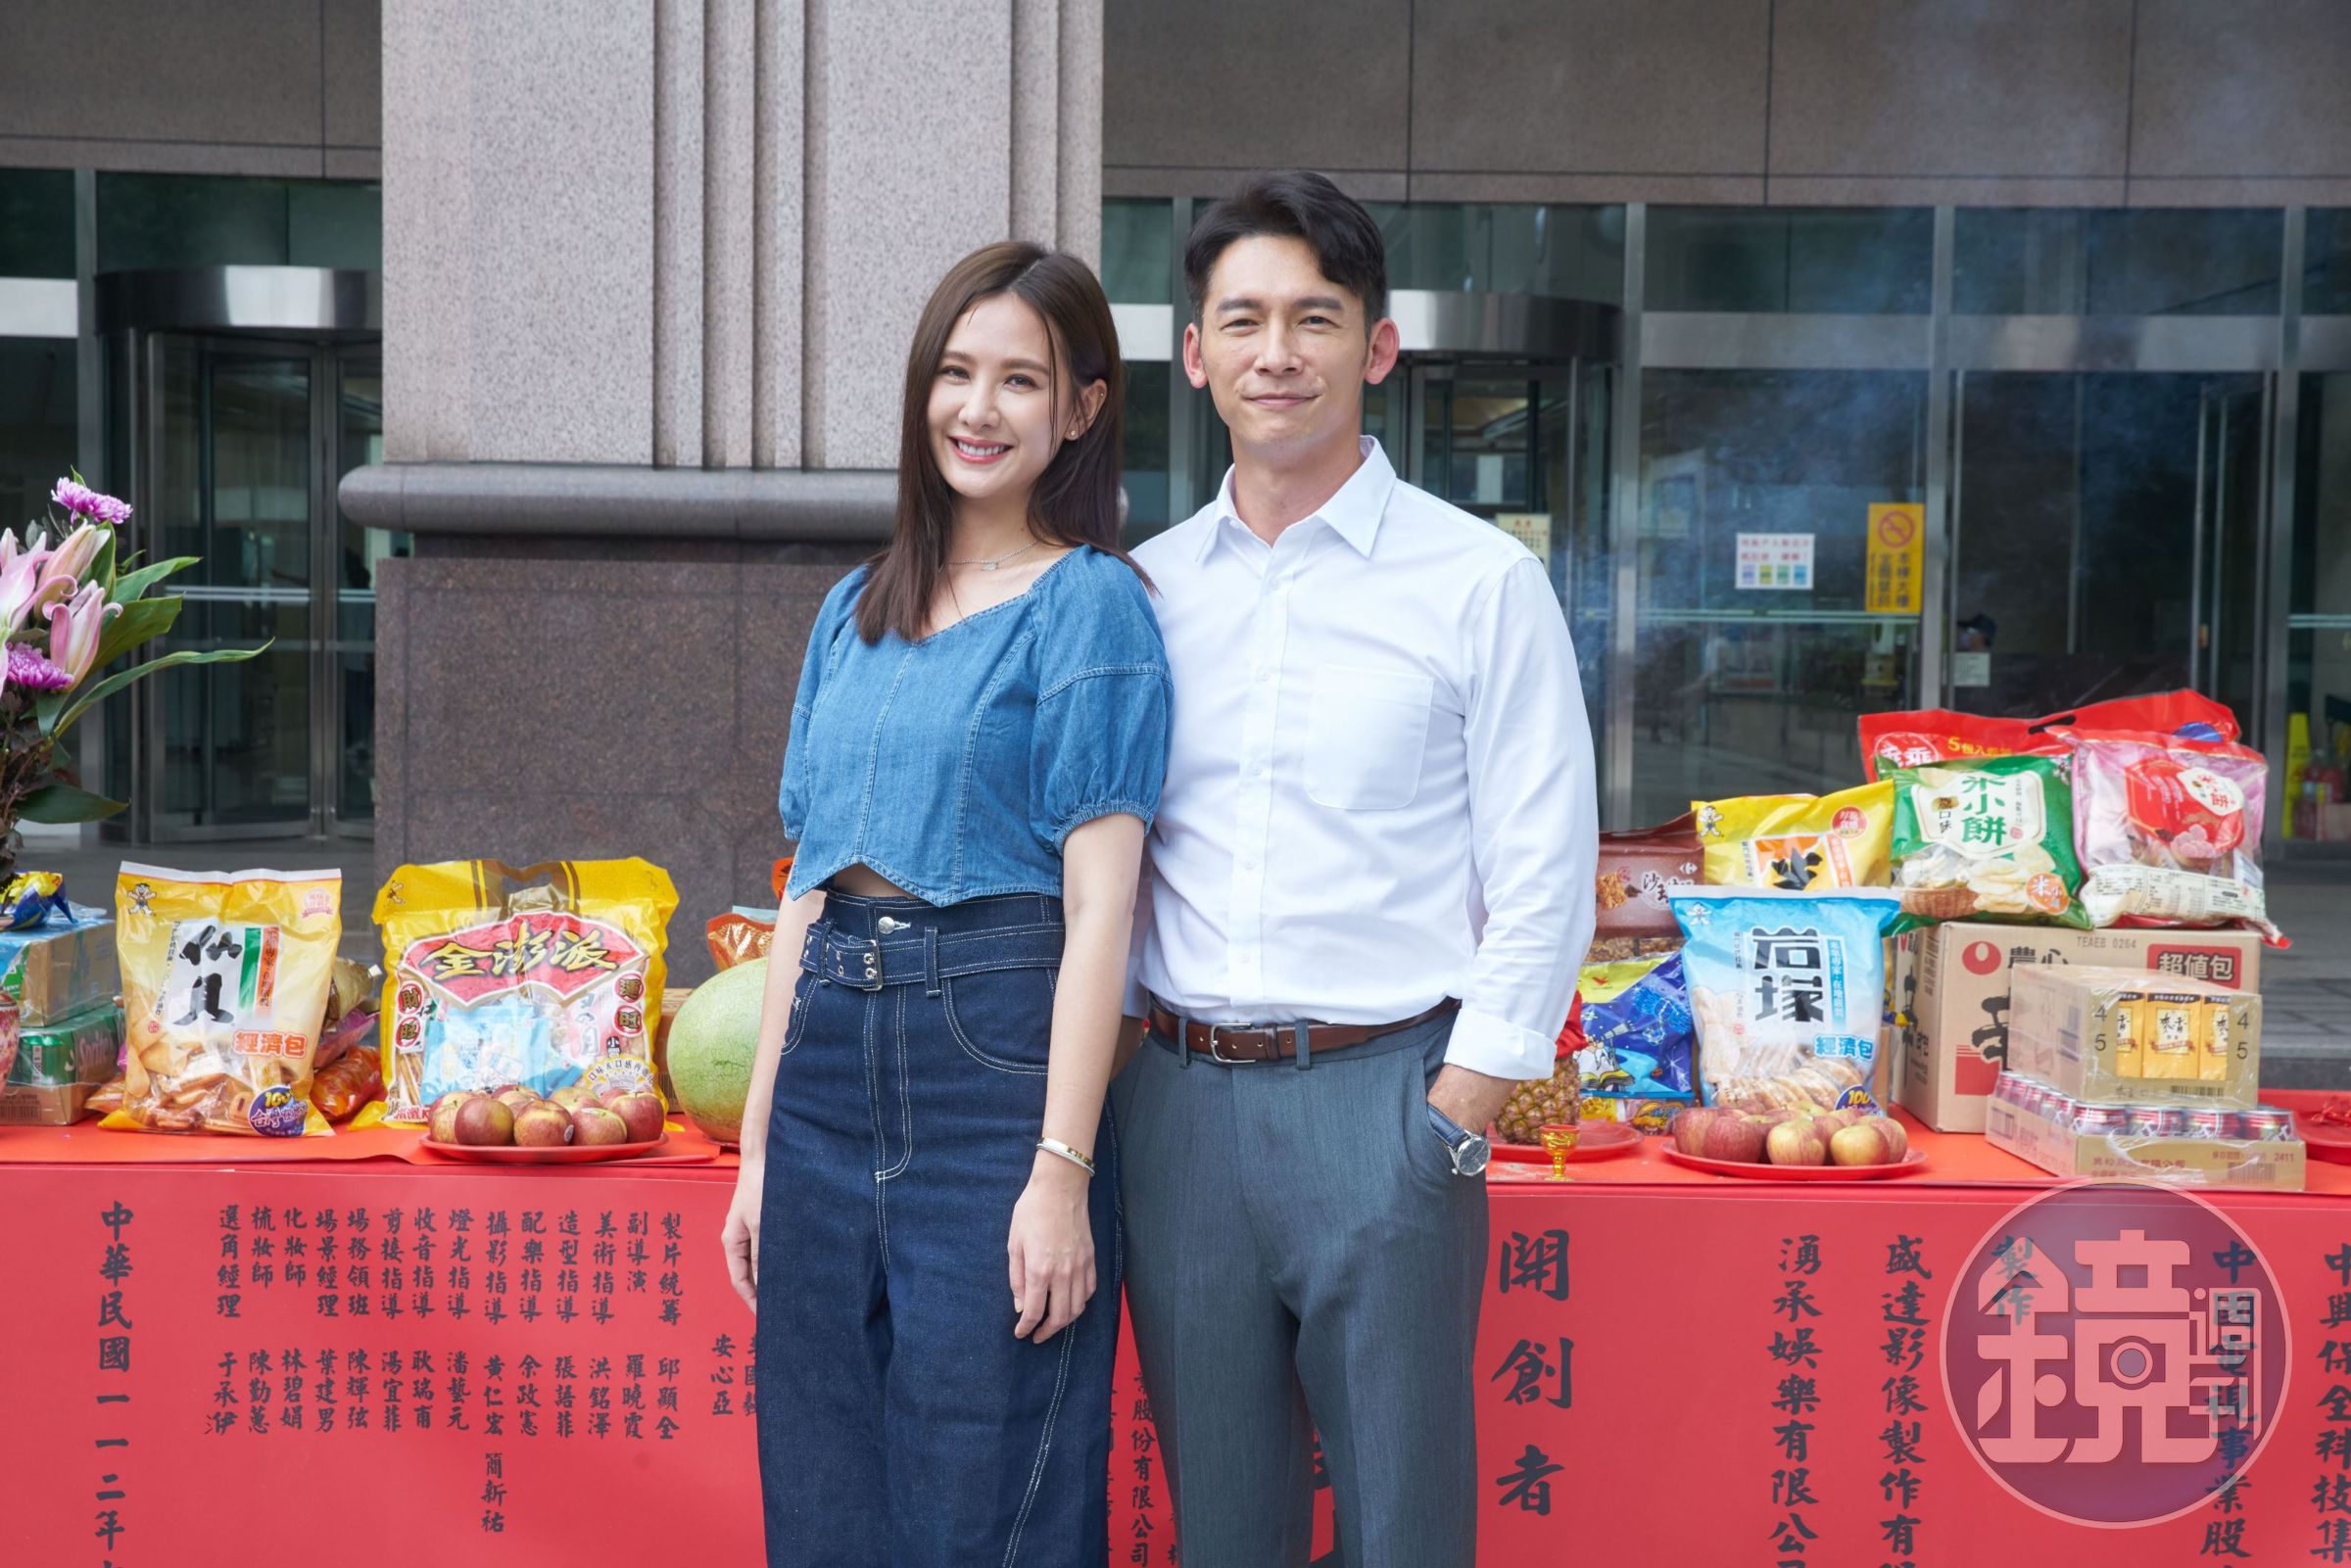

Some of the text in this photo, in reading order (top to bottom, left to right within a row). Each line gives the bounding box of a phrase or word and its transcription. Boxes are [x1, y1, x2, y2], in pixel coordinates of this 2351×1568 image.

[173, 925, 243, 1026] 仙貝
[1752, 927, 1824, 1022] 岩塚
[2158, 952, 2234, 981] 超值包
[2237, 1012, 2249, 1028] 4
[234, 1031, 308, 1059] 經濟包
[1814, 1034, 1874, 1060] 經濟包
[2094, 1033, 2106, 1052] 5
[2237, 1042, 2248, 1060] 5
[217, 1205, 241, 1318] 選角經理
[251, 1206, 276, 1288] 梳妝師
[347, 1208, 371, 1316] 場務領班
[381, 1208, 405, 1320] 剪接指導
[412, 1207, 437, 1319] 收音指導
[484, 1211, 511, 1325] 攝影指導
[280, 1207, 308, 1430] 化妝師 林碧娟
[315, 1209, 339, 1433] 場景經理 葉建男
[447, 1208, 475, 1431] 燈光指導 潘藝元
[516, 1211, 547, 1437] 配樂指導 余政憲
[554, 1210, 581, 1439] 造型指導 張語菲
[588, 1211, 618, 1440] 美術指導 洪銘澤
[622, 1211, 650, 1440] 副導演 羅曉霞
[654, 1212, 683, 1440] 製片統籌 邱顯全
[710, 1333, 737, 1416] 安心亞
[1491, 1229, 1574, 1516] 開創者
[95, 1201, 134, 1568] 中華民國一一二年
[1767, 1234, 1824, 1568] 湧承娛樂有限公
[1879, 1234, 1933, 1568] 盛達影像製作有
